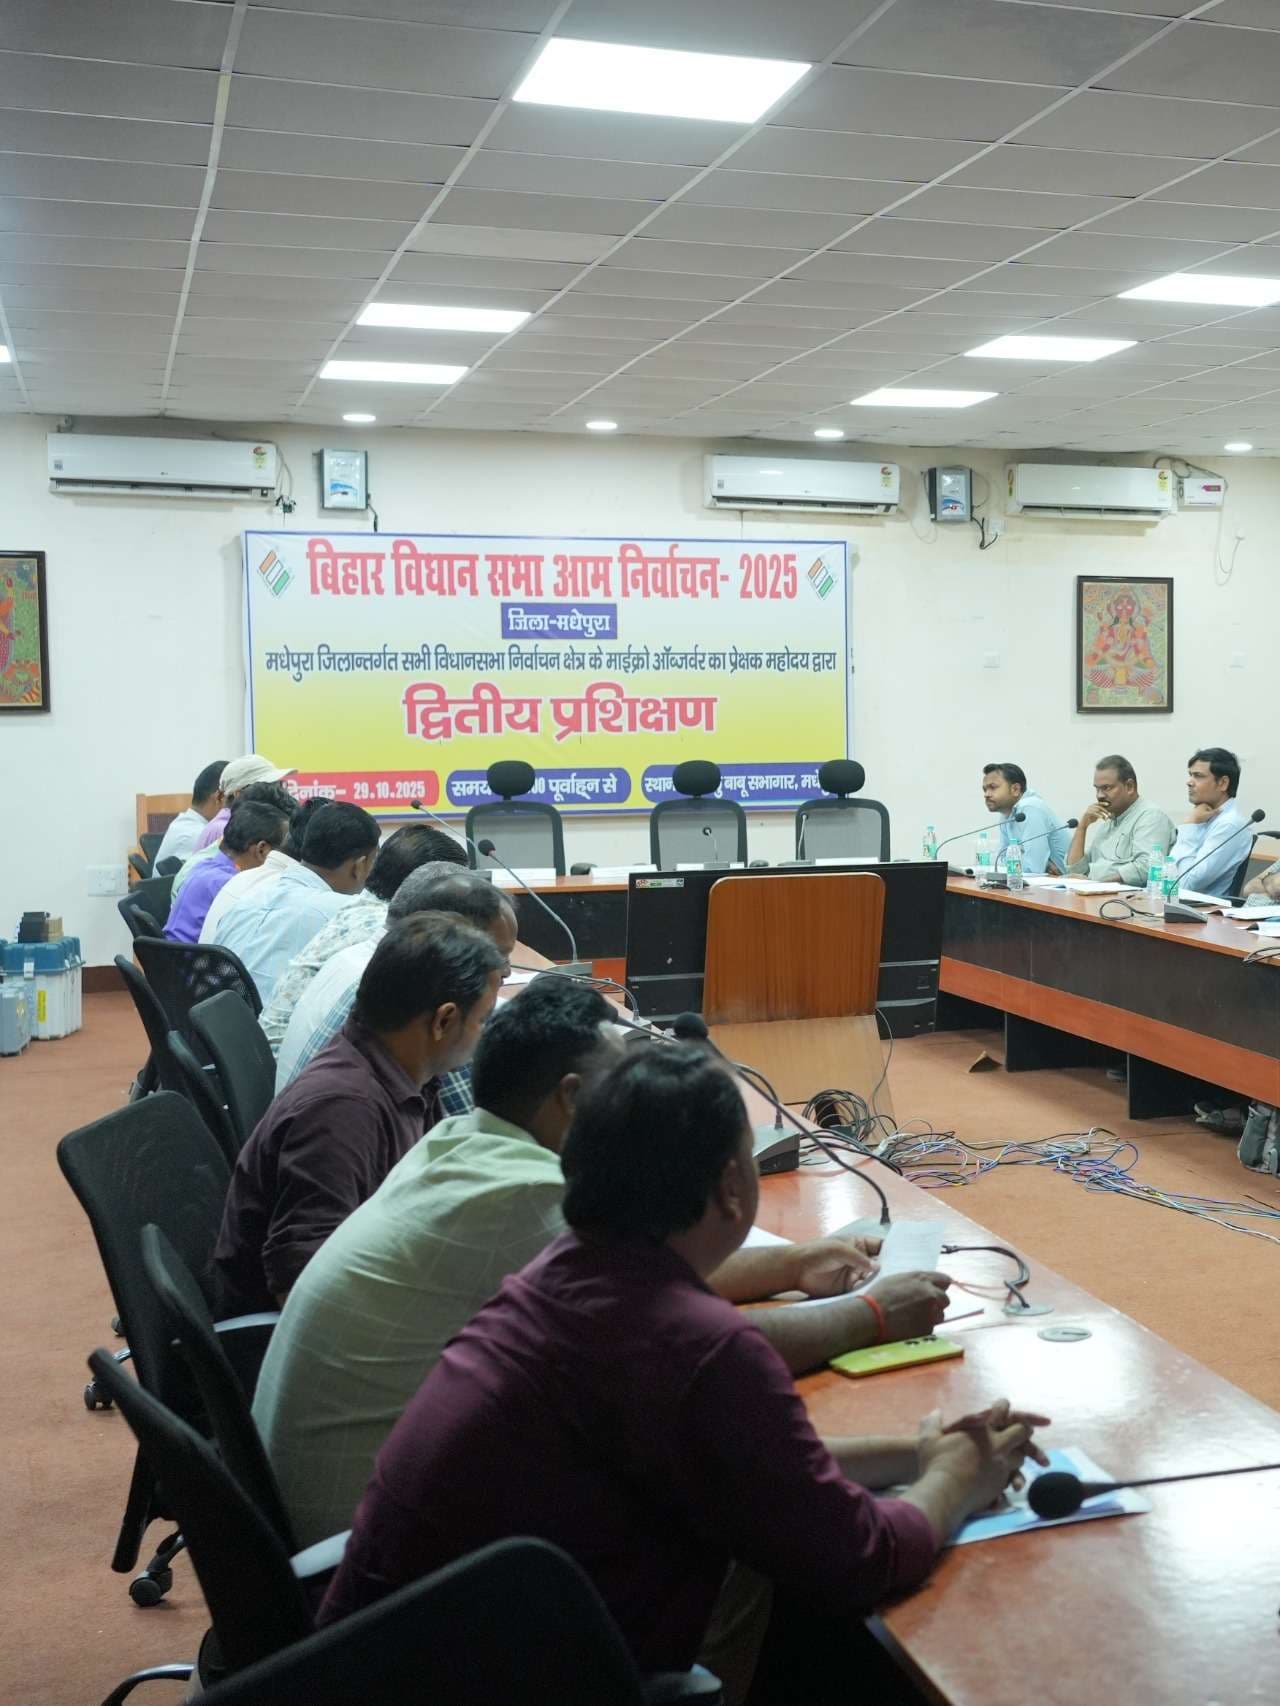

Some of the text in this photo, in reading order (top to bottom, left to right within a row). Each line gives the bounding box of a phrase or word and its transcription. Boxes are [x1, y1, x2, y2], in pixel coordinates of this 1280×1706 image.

[306, 538, 385, 596] बिहार
[391, 539, 478, 597] विधान
[485, 553, 544, 597] सभा
[553, 554, 612, 598] आम
[740, 553, 798, 599] 2025
[508, 607, 610, 637] जिला-मधेपुरा
[266, 643, 837, 682] मधेपुरा जिलान्तर्गत सभी विधानसभा निर्वाचन क्षेत्र के माईक्रो ऑब्जर्वर का प्रेक्षक महोदय द्वारा
[402, 682, 718, 741] द्वितीय प्रशिक्षण
[354, 780, 426, 799] 29.10.2025
[602, 773, 617, 793] से
